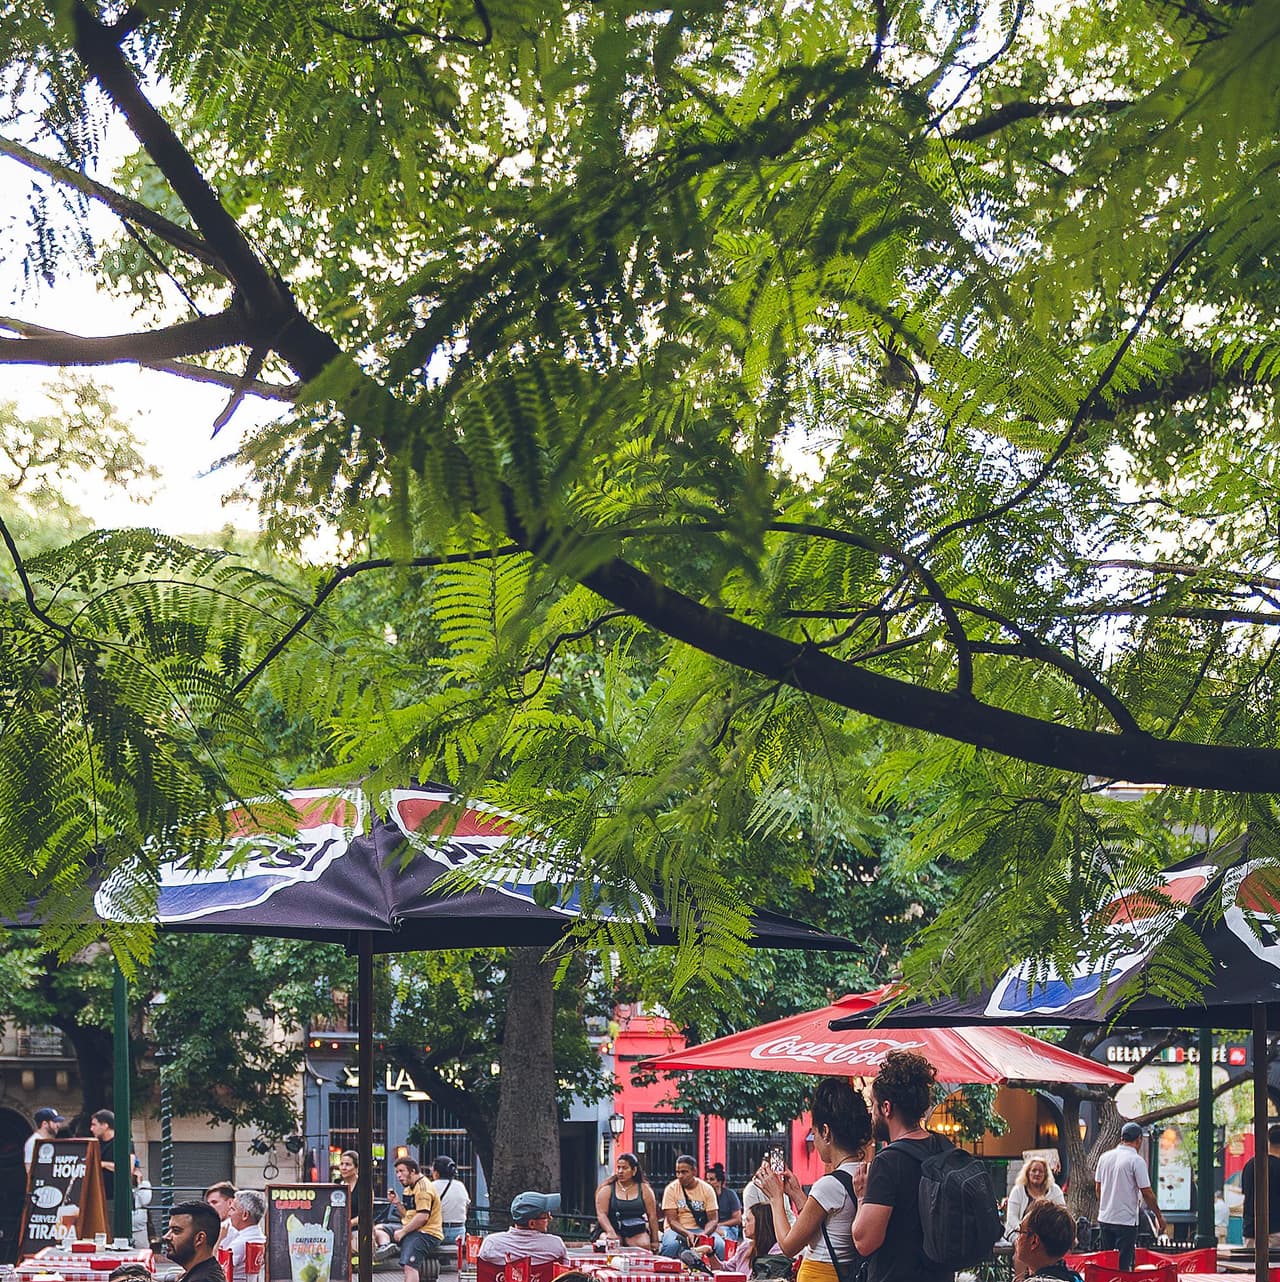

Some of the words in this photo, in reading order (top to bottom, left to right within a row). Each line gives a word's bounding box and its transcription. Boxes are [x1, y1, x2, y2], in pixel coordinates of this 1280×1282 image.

[53, 1164, 86, 1178] HOUR
[271, 1190, 315, 1201] PROMO
[29, 1224, 77, 1240] TIRADA
